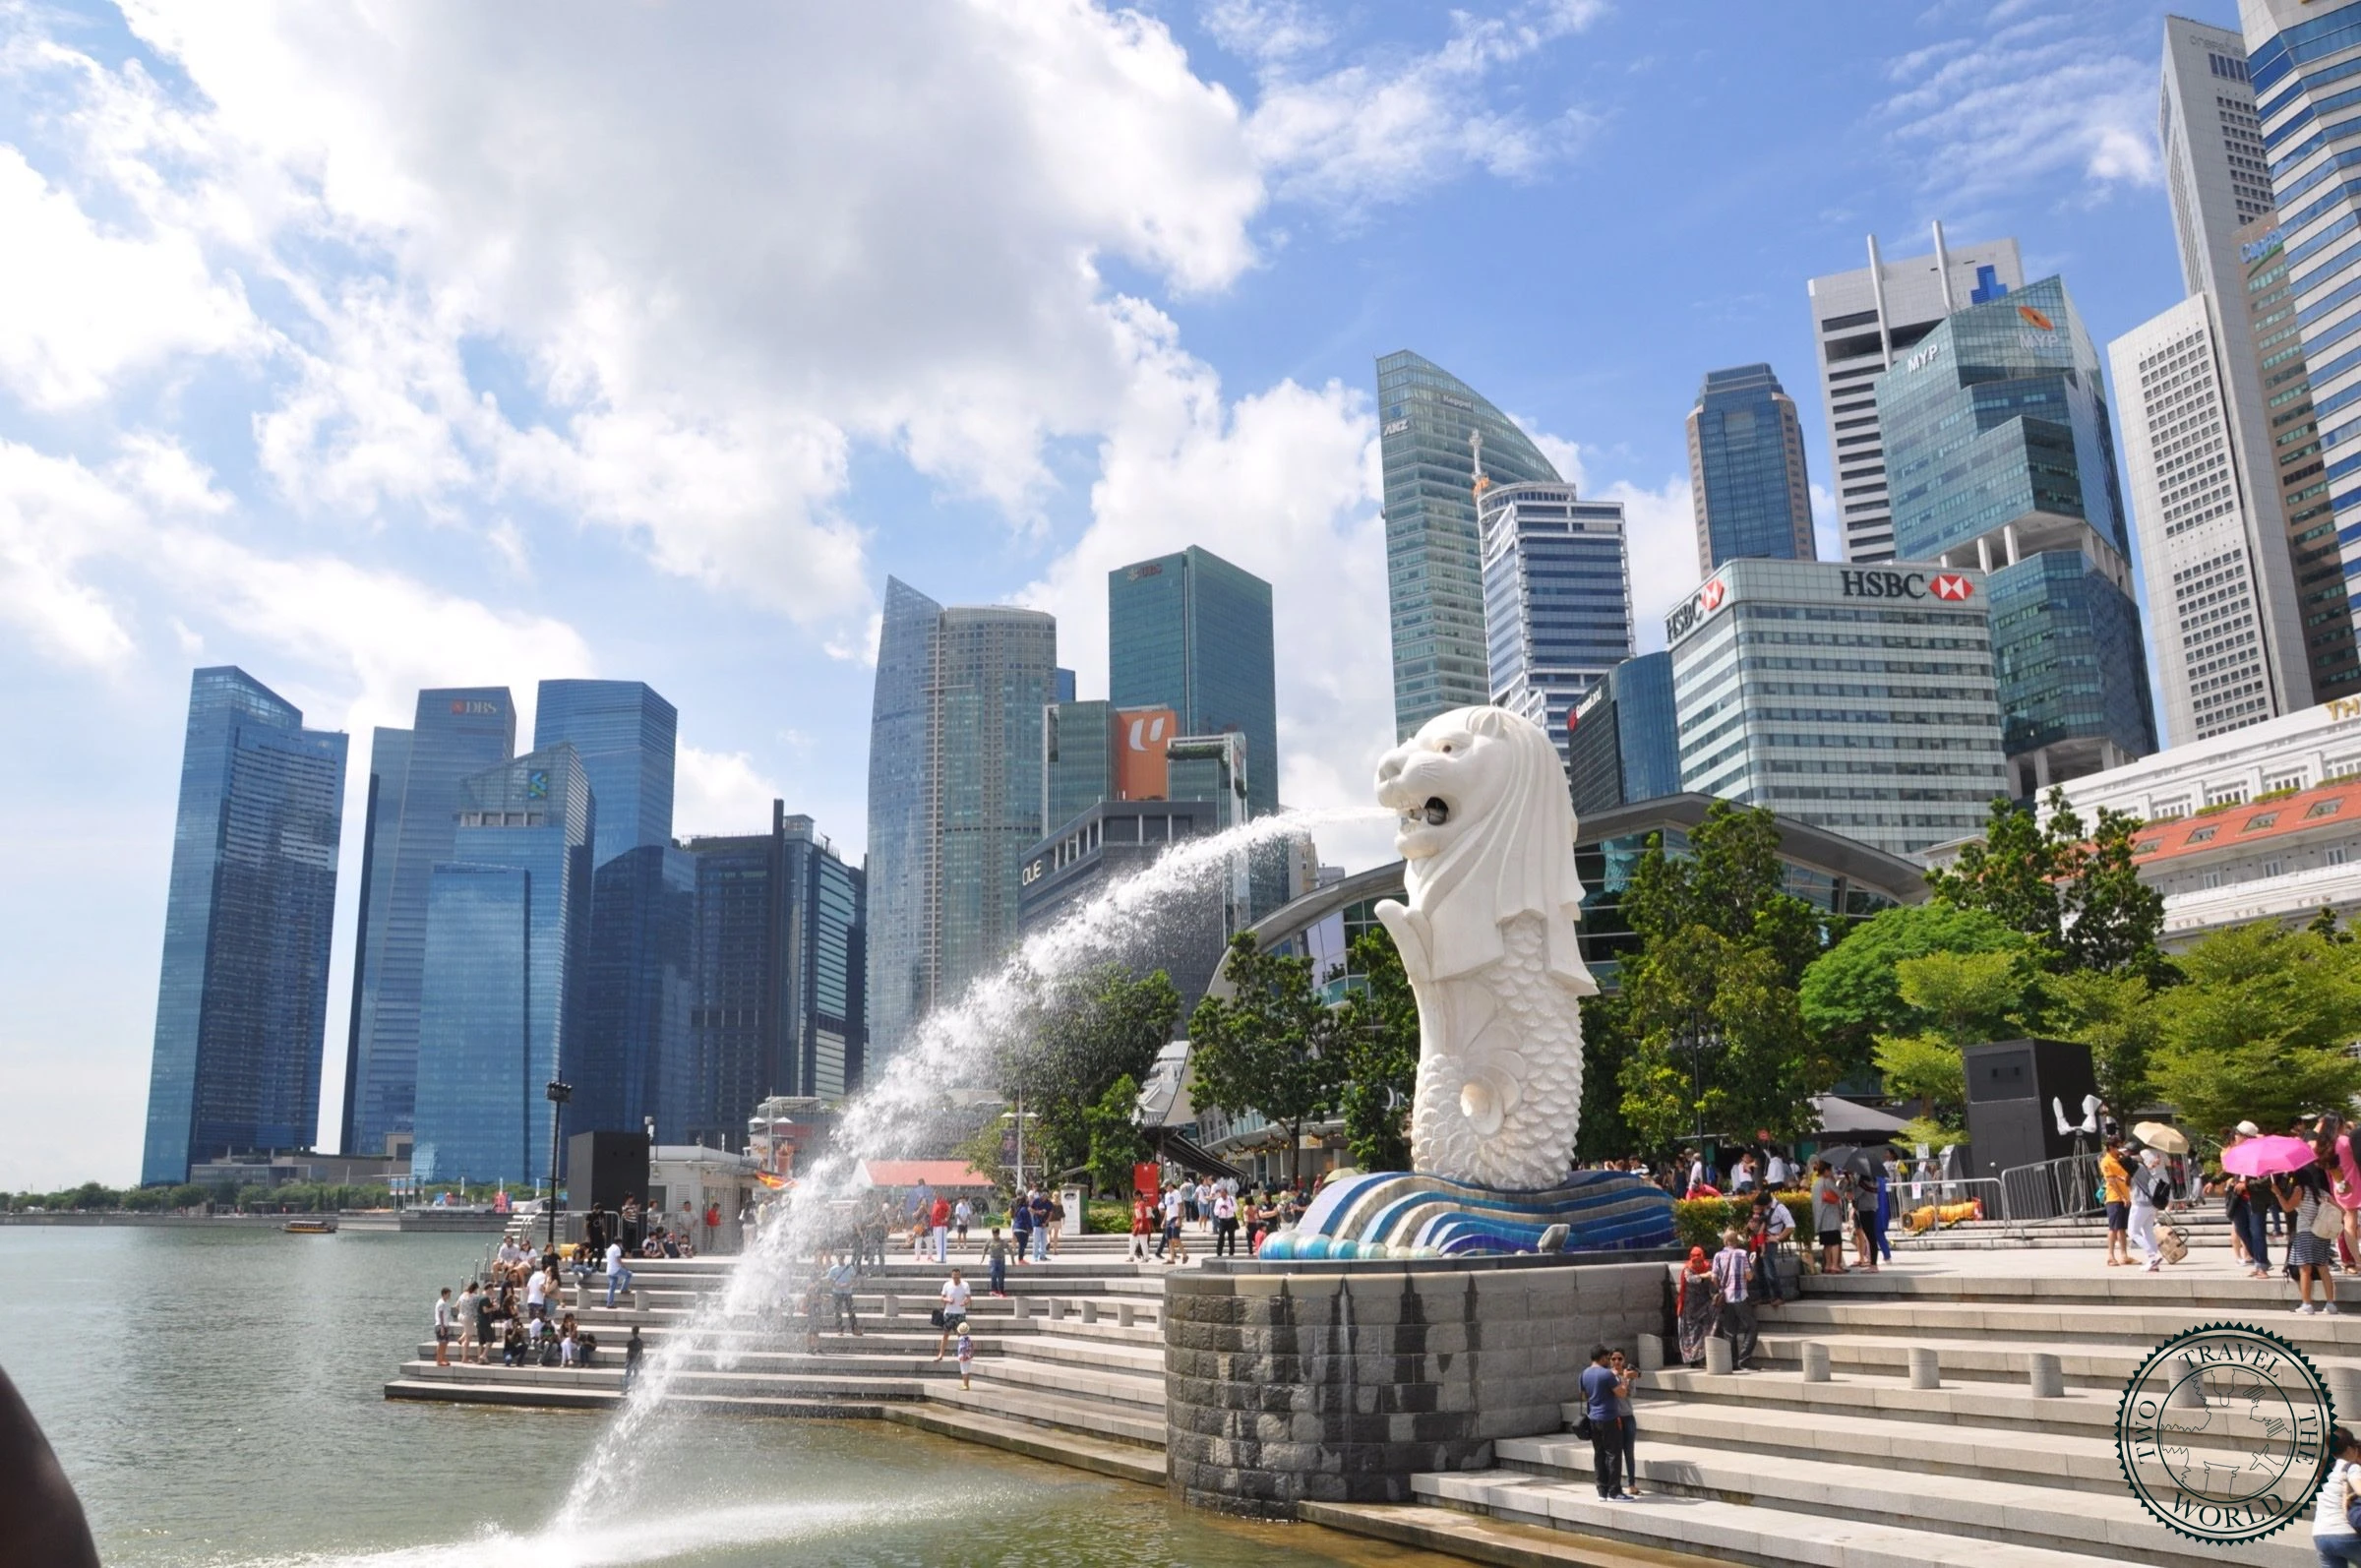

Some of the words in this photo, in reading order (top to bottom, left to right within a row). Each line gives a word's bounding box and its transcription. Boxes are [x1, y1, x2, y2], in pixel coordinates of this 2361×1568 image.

[2018, 333, 2059, 350] MYP
[1907, 344, 1938, 372] MYP
[1383, 420, 1410, 437] ANZ
[1841, 571, 1926, 599] HSBC
[1665, 592, 1704, 643] HSBC
[465, 700, 497, 713] DBS
[1022, 859, 1042, 886] OUE
